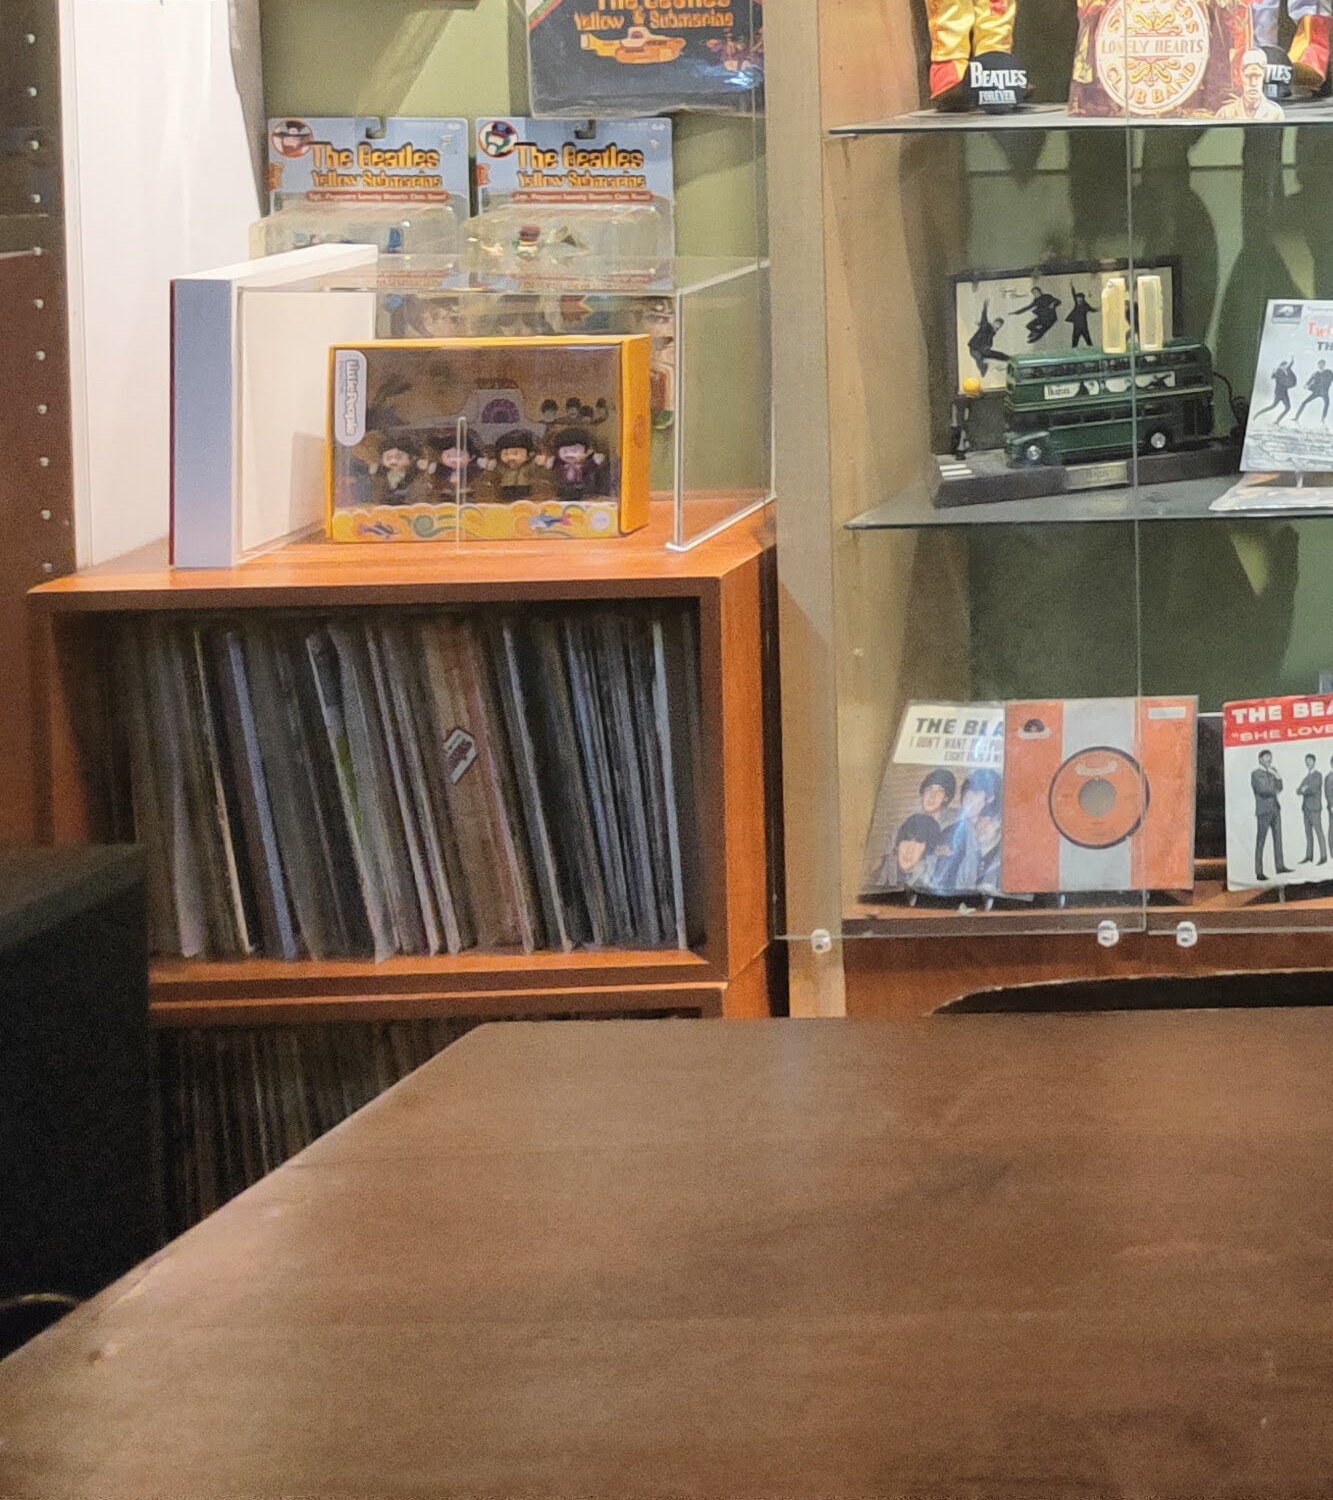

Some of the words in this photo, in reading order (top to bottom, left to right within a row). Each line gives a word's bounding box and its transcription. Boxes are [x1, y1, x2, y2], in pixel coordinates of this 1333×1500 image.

[574, 10, 625, 31] Yellow
[650, 9, 735, 29] Submarine
[1154, 39, 1205, 54] HEARTS
[969, 61, 1028, 90] BEATLES
[1265, 63, 1293, 84] TLES
[978, 90, 1017, 105] FOREVER
[310, 141, 354, 169] The
[357, 141, 441, 170] Beatles
[513, 141, 558, 169] The
[562, 141, 645, 170] Beatles
[1231, 705, 1283, 725] THE
[915, 717, 958, 735] THE
